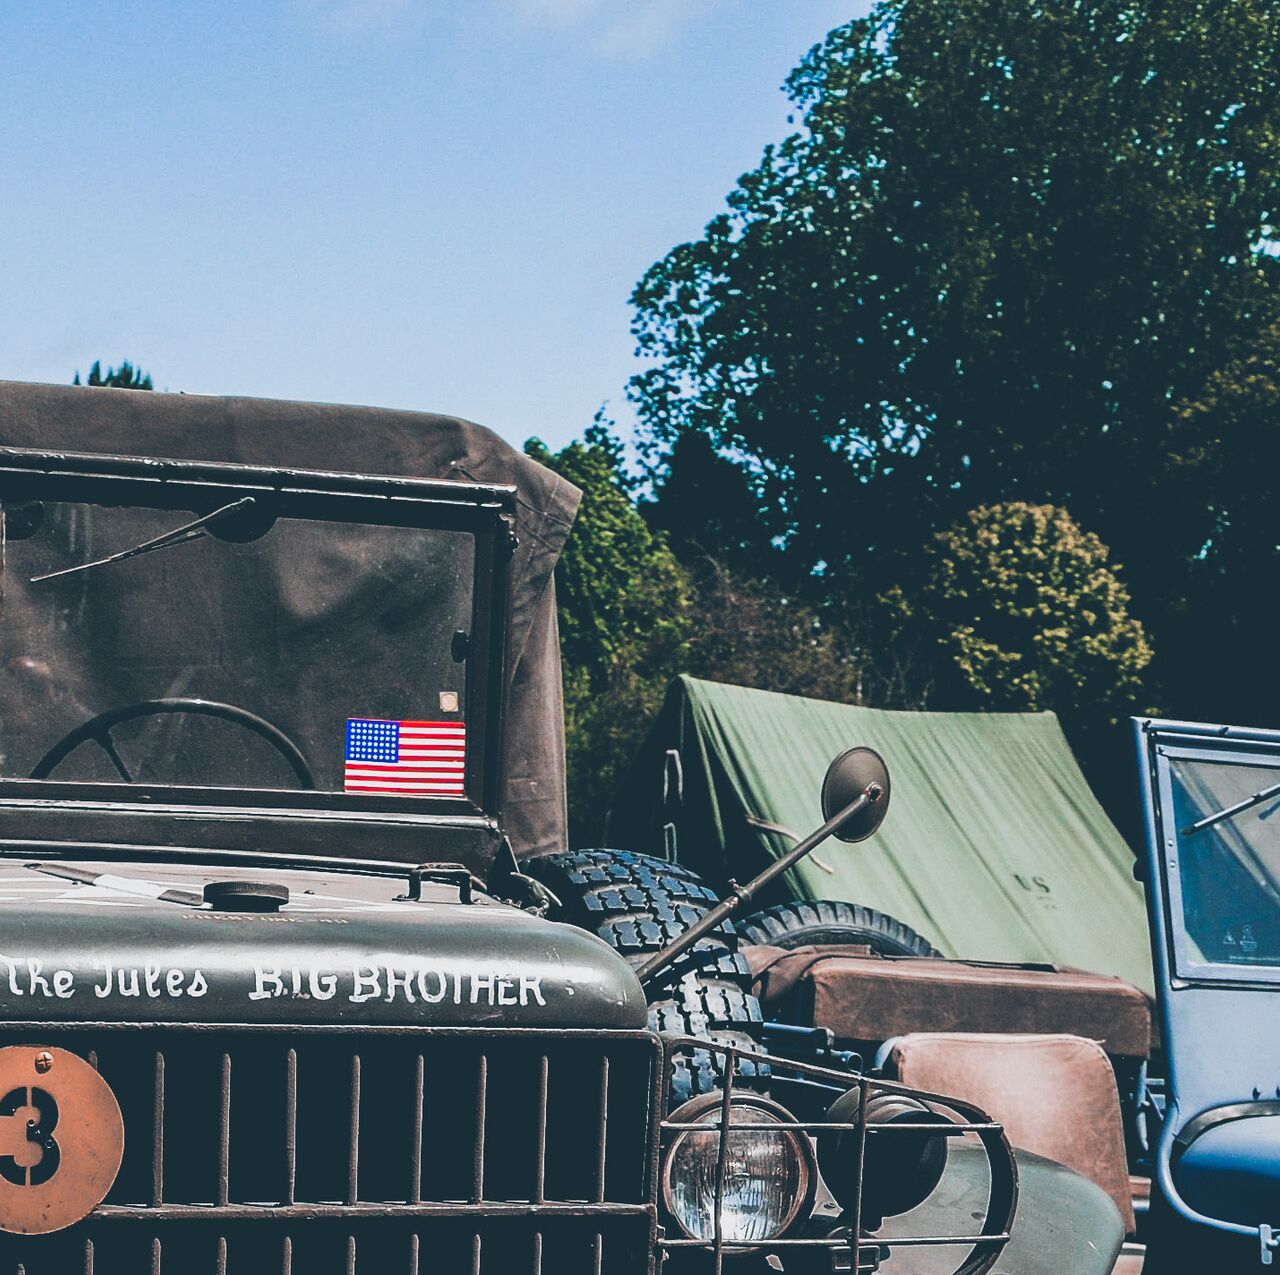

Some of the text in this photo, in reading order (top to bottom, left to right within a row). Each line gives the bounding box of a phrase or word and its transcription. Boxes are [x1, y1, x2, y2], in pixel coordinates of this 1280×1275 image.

[94, 958, 208, 998] Jules
[249, 961, 338, 1001] BIG
[348, 960, 547, 1006] BROTHER
